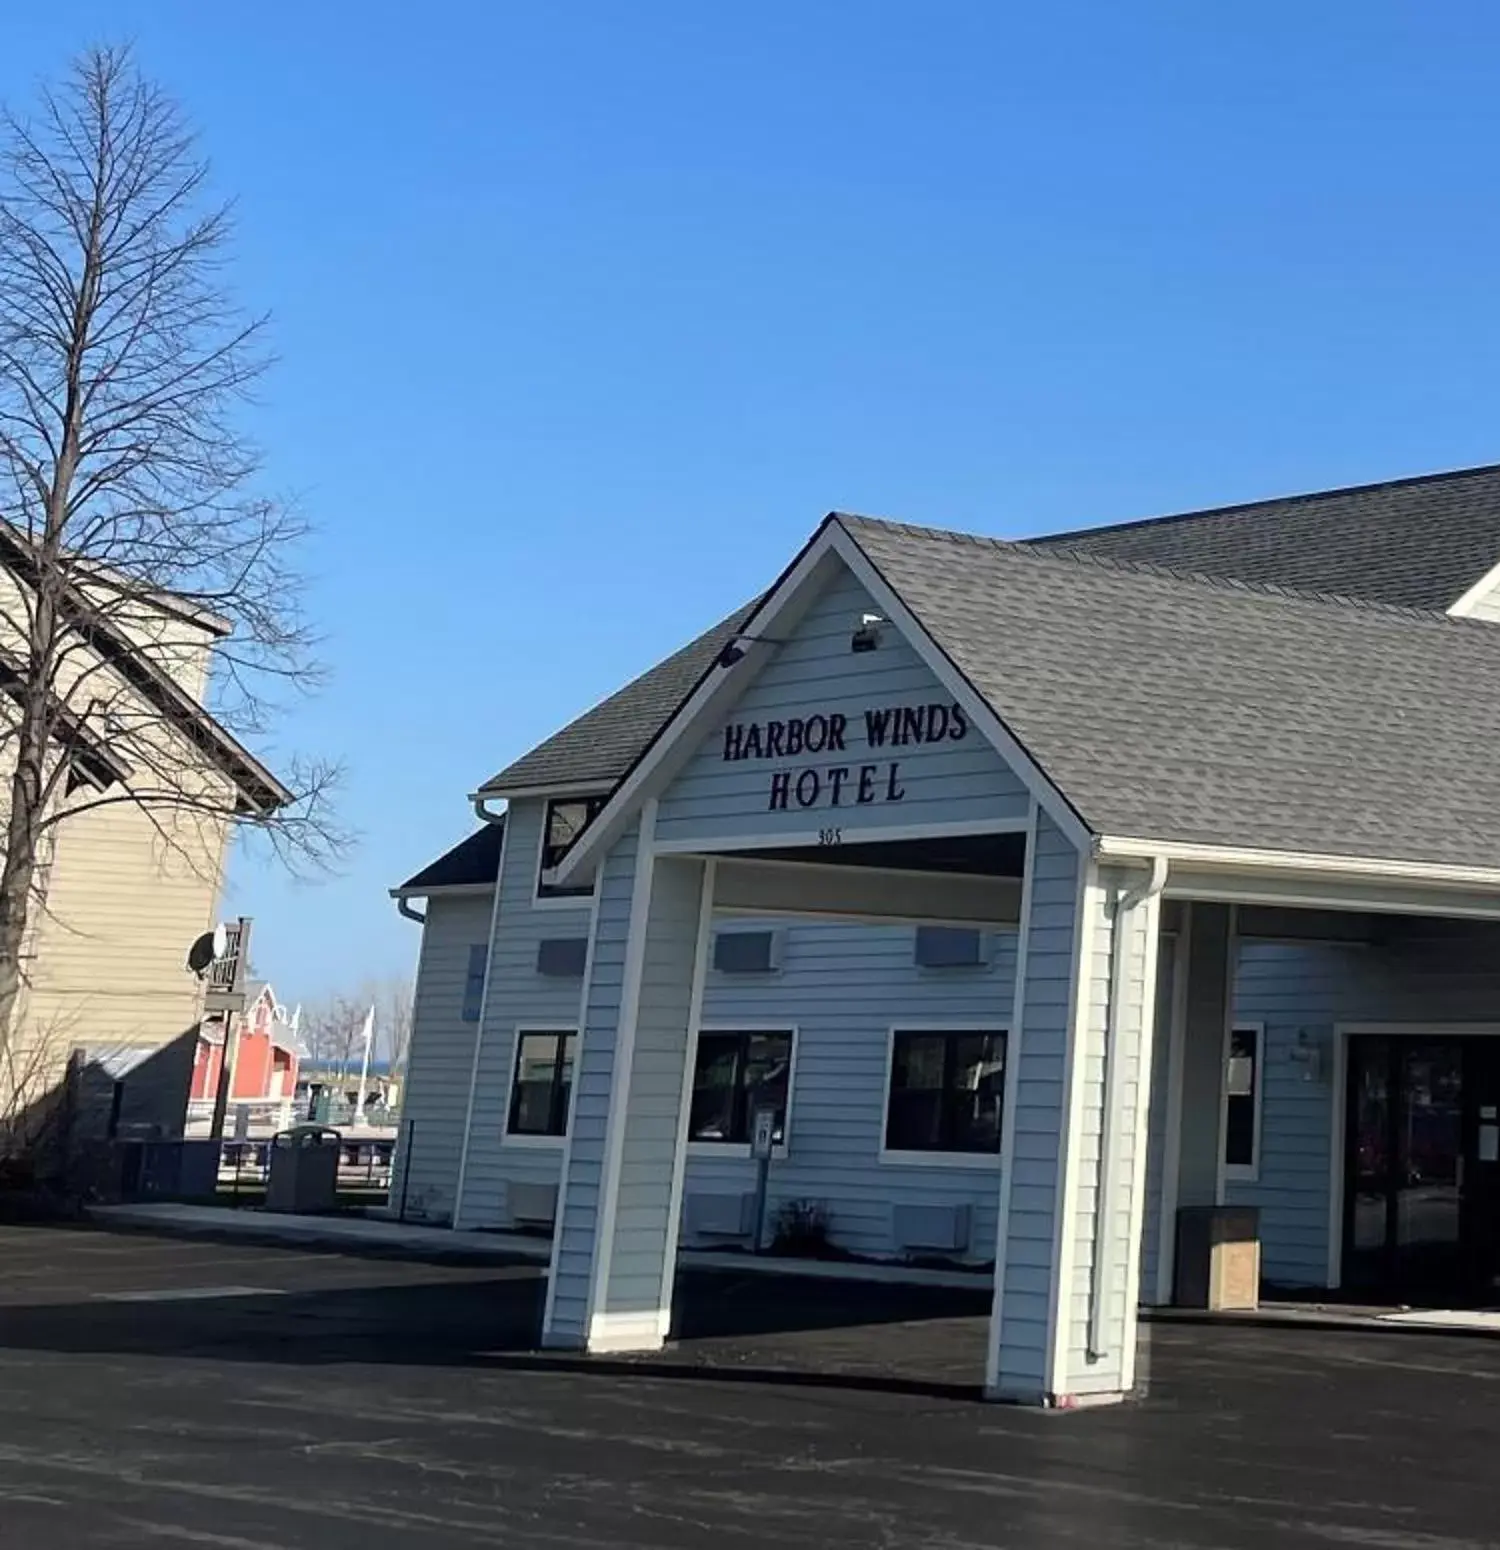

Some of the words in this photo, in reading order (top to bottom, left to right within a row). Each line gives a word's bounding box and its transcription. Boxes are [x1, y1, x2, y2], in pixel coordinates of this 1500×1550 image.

[722, 713, 847, 762] HARBOR
[864, 702, 968, 748] WINDS
[768, 762, 905, 811] HOTEL
[818, 828, 842, 846] 305
